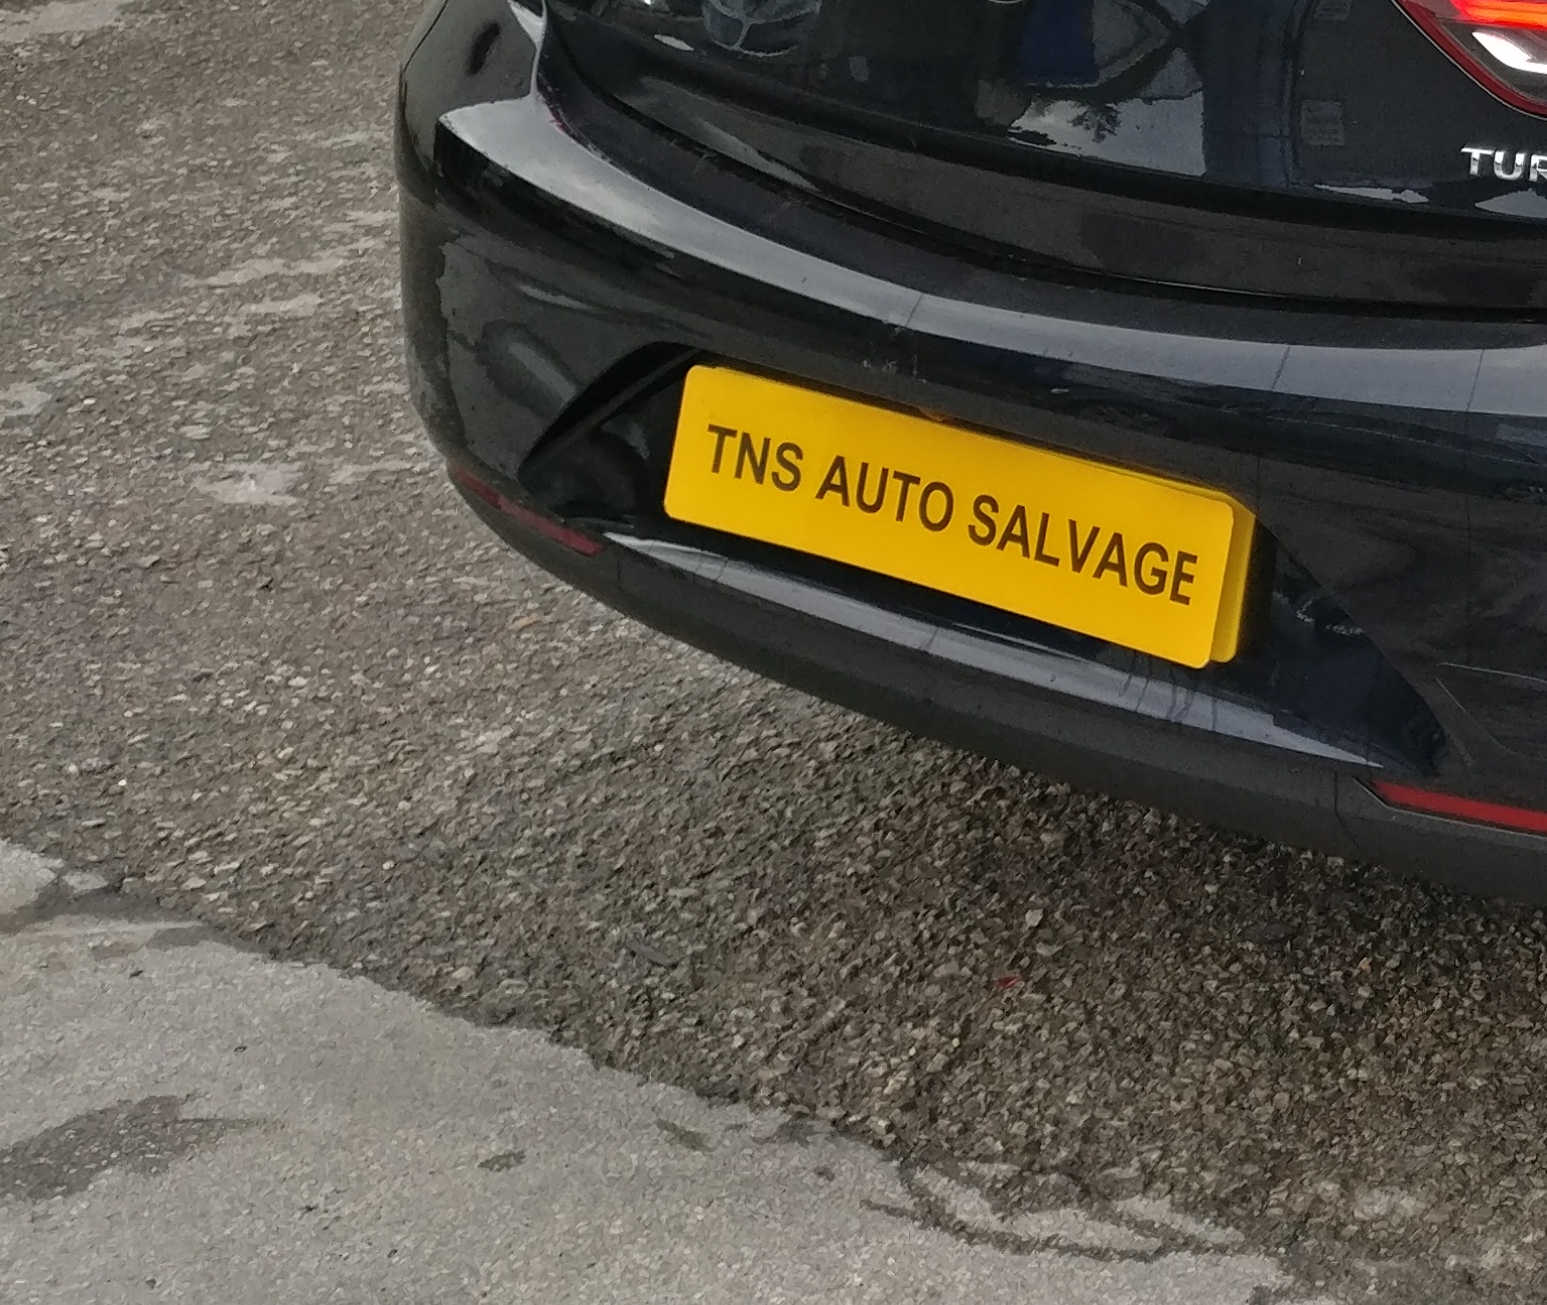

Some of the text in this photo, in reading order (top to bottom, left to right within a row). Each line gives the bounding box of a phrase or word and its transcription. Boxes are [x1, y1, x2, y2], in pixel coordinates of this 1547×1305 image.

[707, 423, 1199, 606] TNS AUTO SALVAGE
